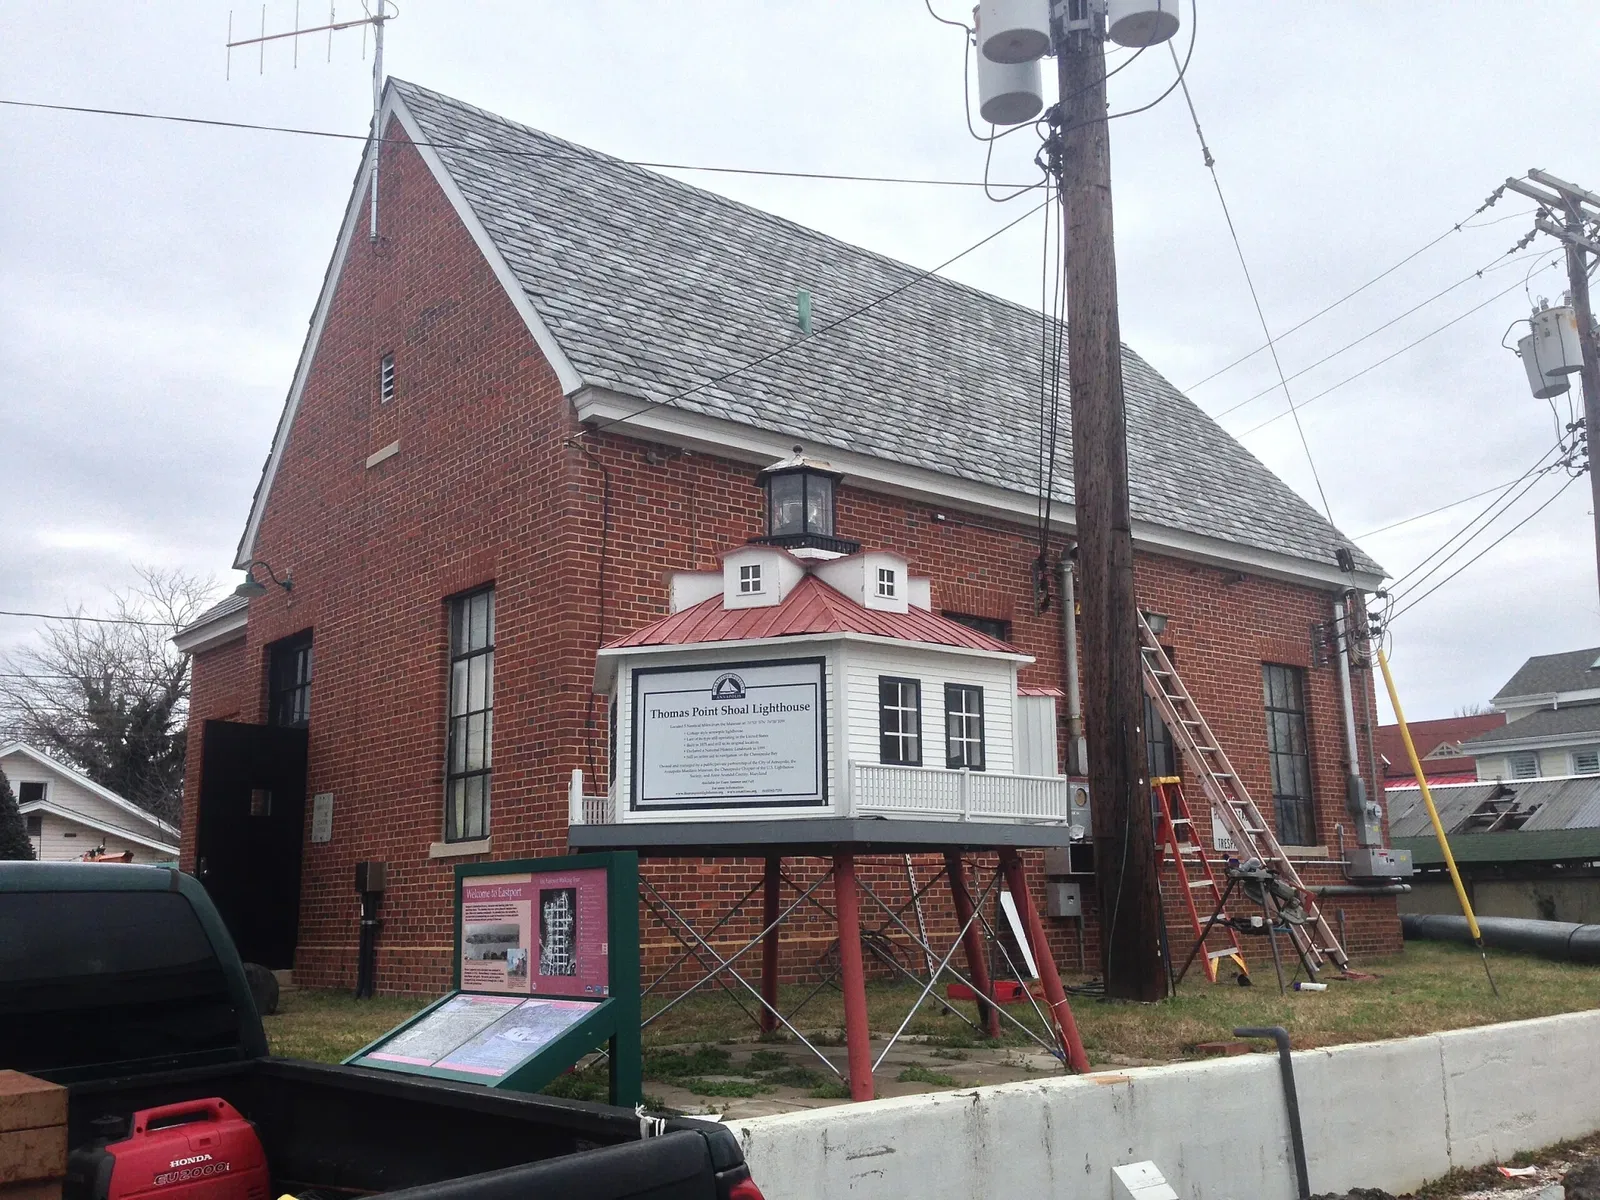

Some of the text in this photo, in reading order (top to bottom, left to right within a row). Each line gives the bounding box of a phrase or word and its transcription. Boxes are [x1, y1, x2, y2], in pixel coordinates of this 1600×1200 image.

[650, 702, 811, 719] Thomas Point Shoal Lighthouse
[465, 886, 522, 900] Welcome to Eastport
[169, 1153, 213, 1168] HONDA
